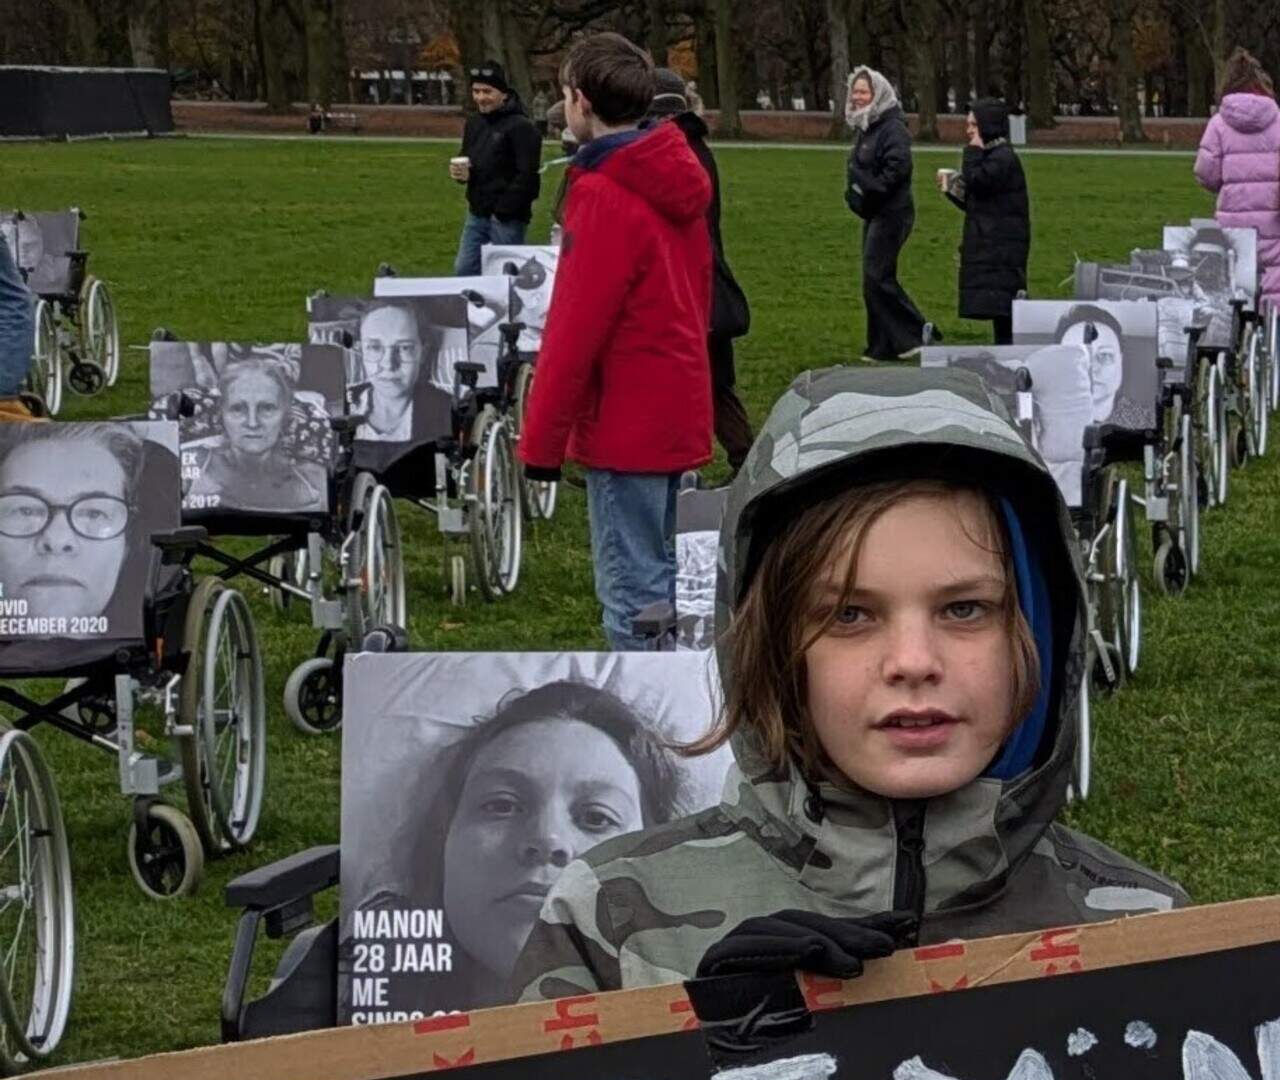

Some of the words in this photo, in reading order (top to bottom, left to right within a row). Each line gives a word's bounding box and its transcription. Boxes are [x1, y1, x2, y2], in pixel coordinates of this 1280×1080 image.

[0, 618, 68, 634] ECEMBER
[71, 617, 109, 633] 2020
[352, 909, 444, 938] MANON
[352, 944, 385, 972] 28
[391, 944, 453, 972] JAAR
[352, 977, 389, 1006] ME
